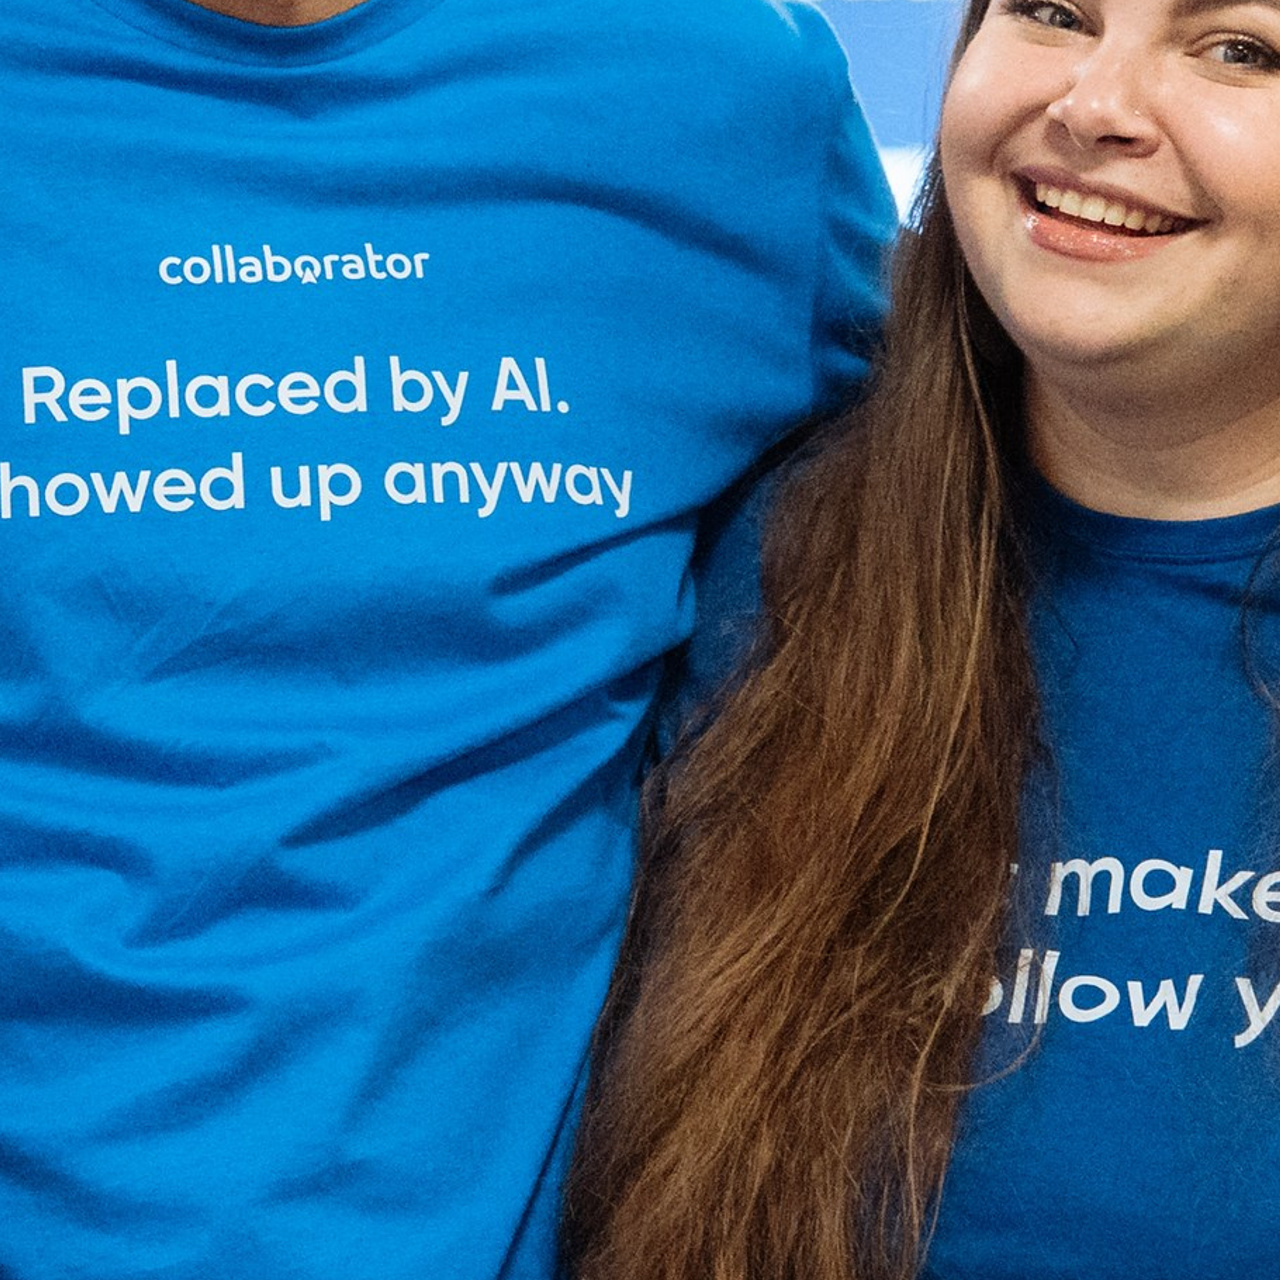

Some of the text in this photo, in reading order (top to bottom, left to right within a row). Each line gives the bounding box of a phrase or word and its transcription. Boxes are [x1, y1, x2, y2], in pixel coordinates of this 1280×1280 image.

[159, 243, 429, 284] collaborator
[21, 355, 570, 435] Replaced by AI.
[270, 460, 362, 521] up
[384, 460, 632, 519] anyway
